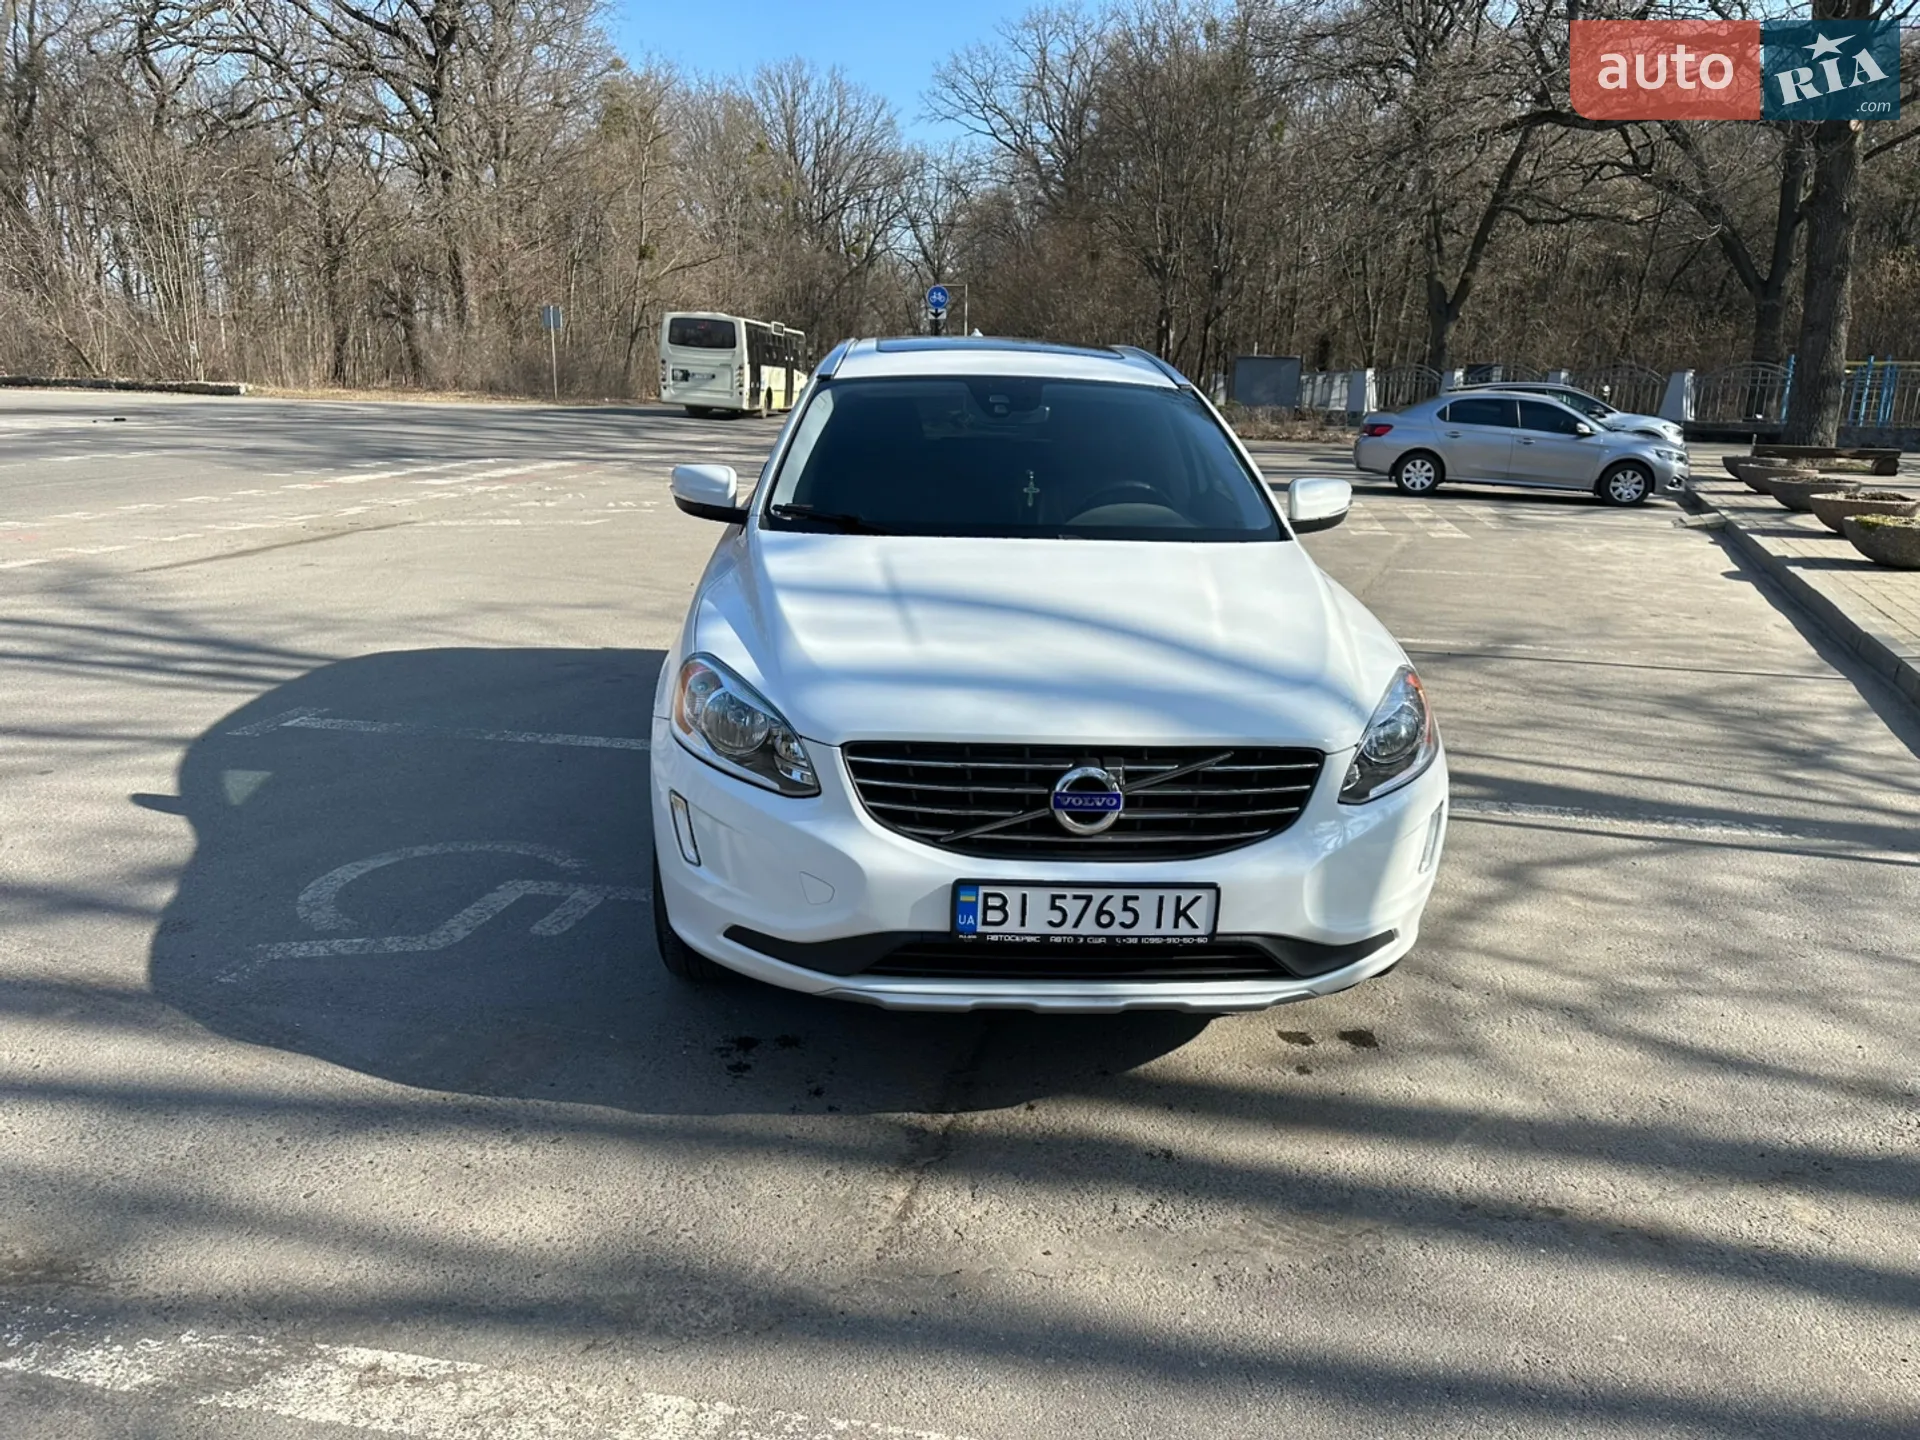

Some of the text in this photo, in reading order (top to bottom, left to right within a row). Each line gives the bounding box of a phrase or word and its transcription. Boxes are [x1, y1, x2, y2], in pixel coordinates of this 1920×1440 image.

[1056, 795, 1118, 807] VOLVO
[981, 892, 1203, 930] BI 5765 IK
[958, 914, 975, 926] UA
